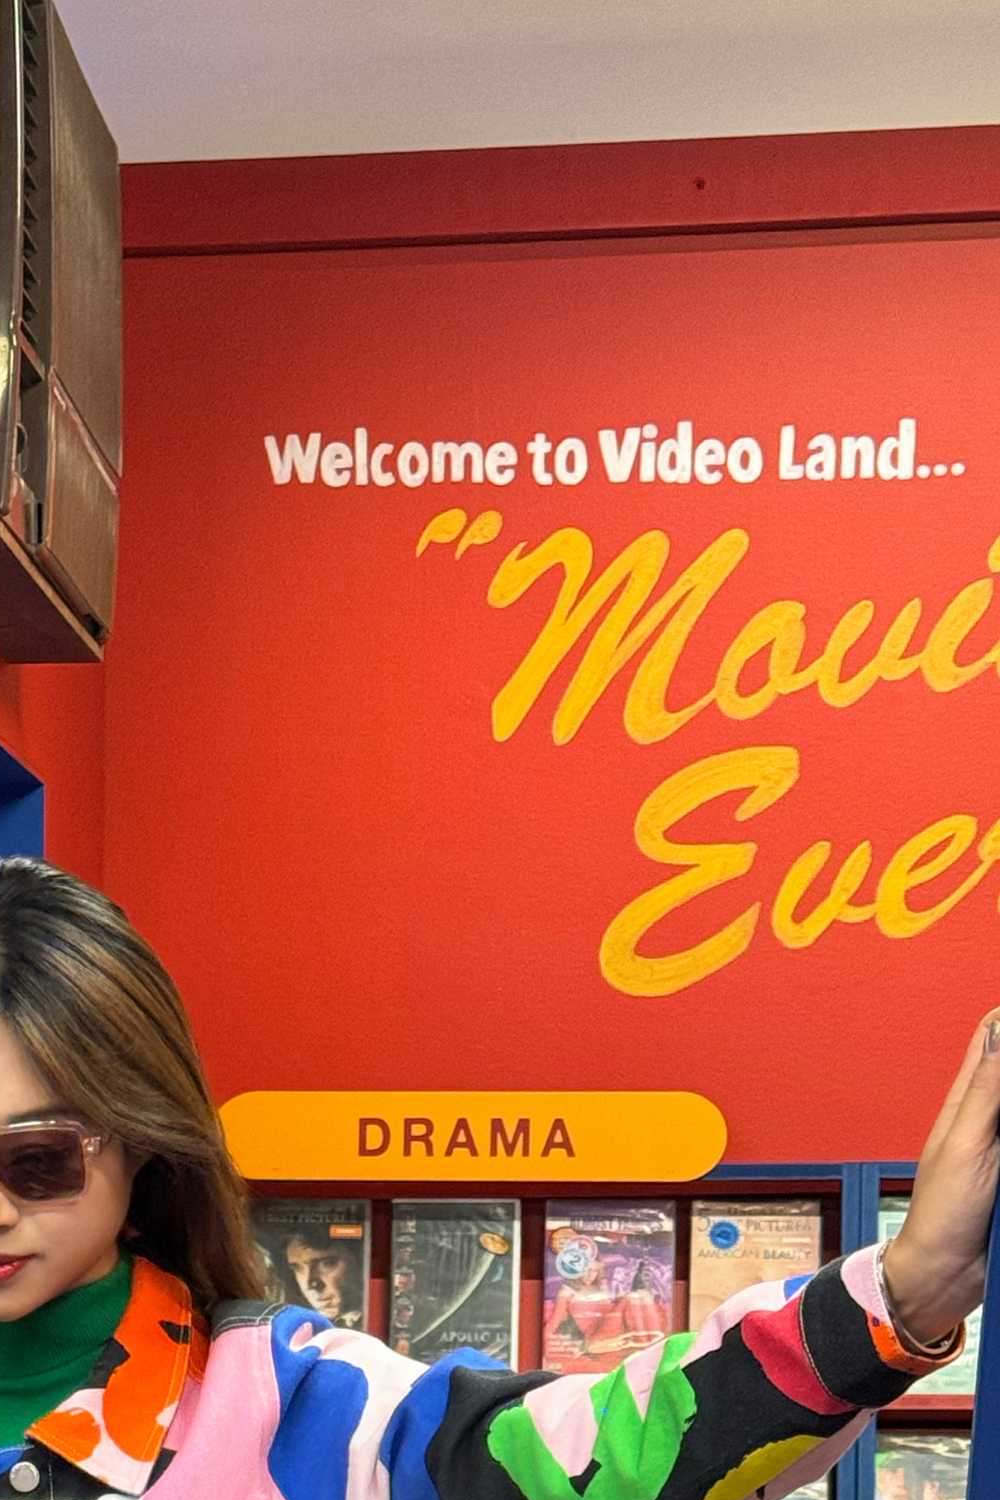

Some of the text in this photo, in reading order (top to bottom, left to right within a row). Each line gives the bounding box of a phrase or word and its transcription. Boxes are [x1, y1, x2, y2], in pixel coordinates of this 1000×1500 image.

[264, 417, 966, 487] Welcome to Video Land...
[357, 1117, 577, 1158] DRAMA
[439, 1331, 491, 1343] APOLLO
